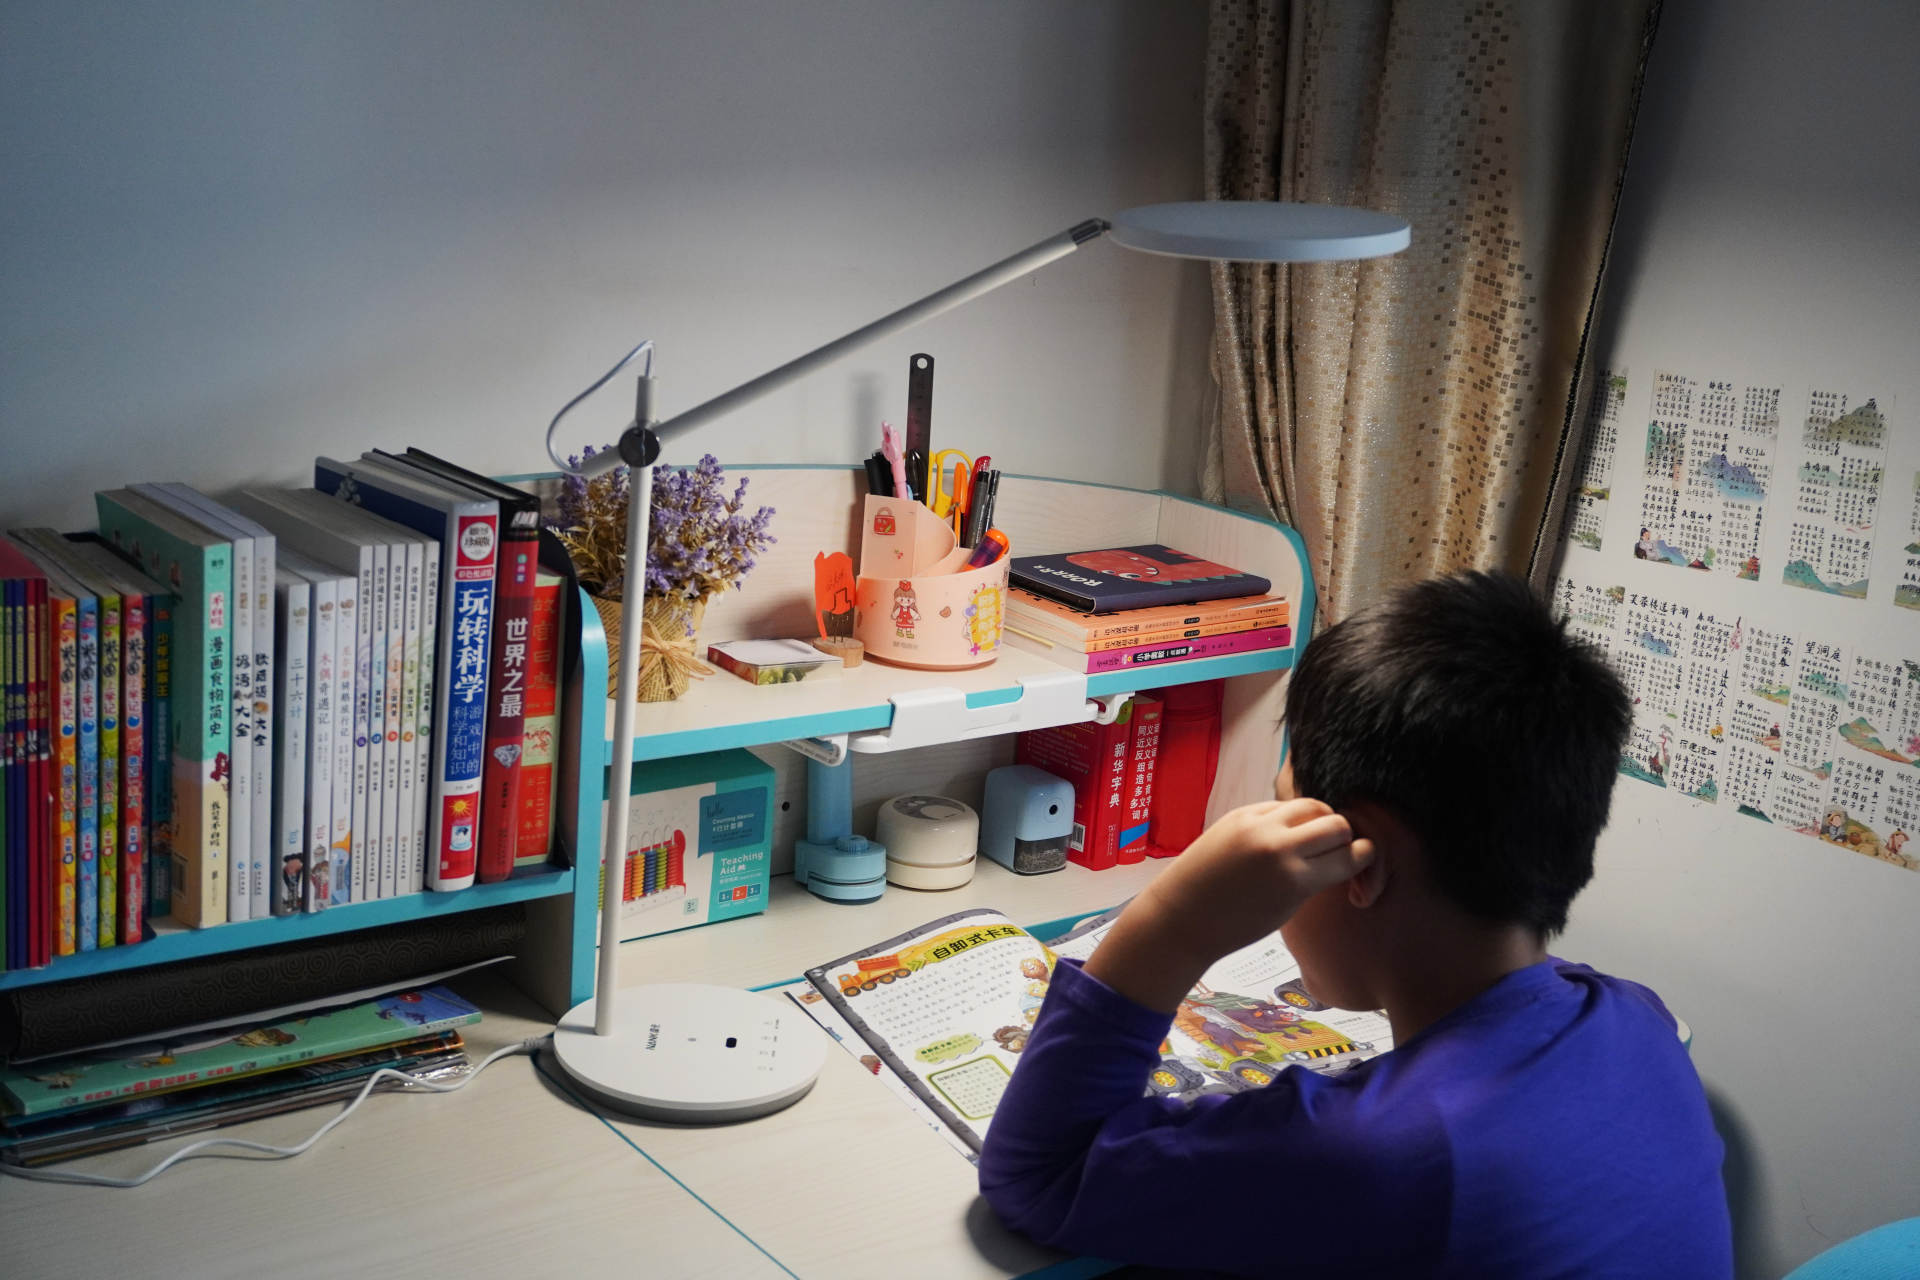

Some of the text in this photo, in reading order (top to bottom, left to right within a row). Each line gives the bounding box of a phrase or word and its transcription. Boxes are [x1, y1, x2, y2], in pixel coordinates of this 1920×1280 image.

[454, 587, 489, 703] 玩转科学
[499, 617, 528, 717] 世界之最
[208, 636, 224, 738] 漫画食物简史
[290, 657, 305, 719] 三十六计
[451, 706, 468, 775] 科学和知识
[466, 705, 482, 774] 游戏中的
[1763, 757, 1774, 780] 山行
[1109, 743, 1125, 808] 新华字典
[720, 865, 736, 876] Aid
[721, 851, 764, 866] Teaching
[932, 925, 1019, 960] 自卸式卡车
